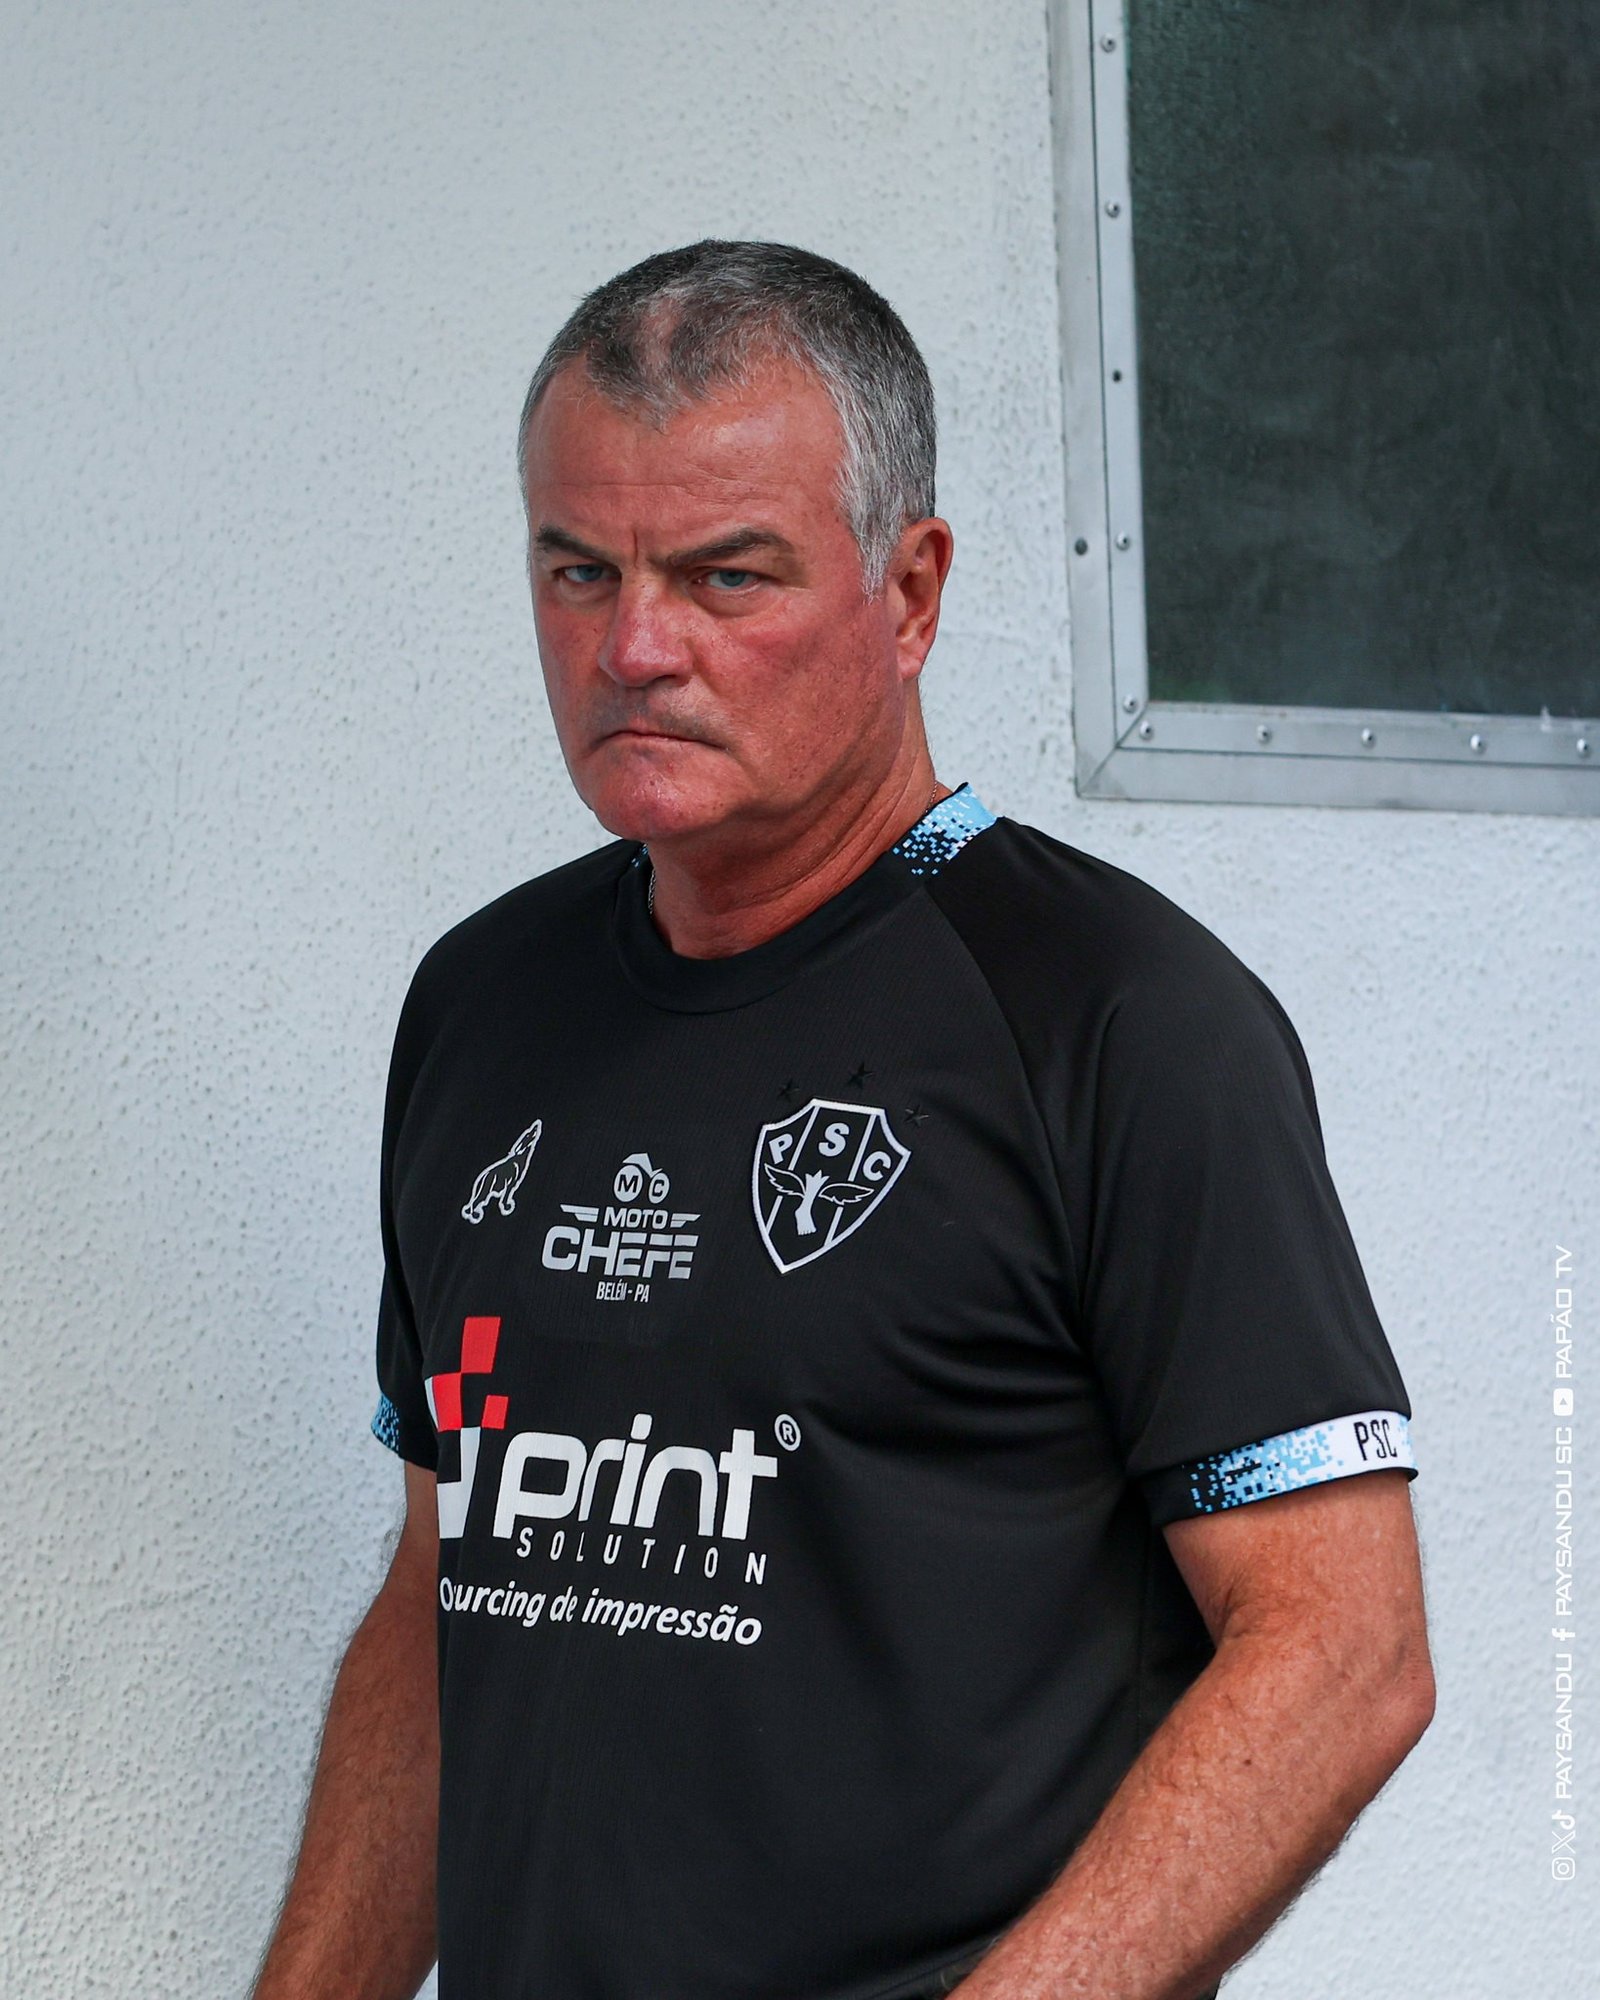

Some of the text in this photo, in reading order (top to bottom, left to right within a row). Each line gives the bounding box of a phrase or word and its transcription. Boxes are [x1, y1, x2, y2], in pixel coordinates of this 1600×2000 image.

[603, 1206, 669, 1230] MOTO
[541, 1225, 699, 1280] CHEFE
[1353, 1418, 1398, 1462] PSC
[516, 1526, 767, 1585] SOLUTION
[549, 1585, 579, 1623] de
[581, 1587, 763, 1647] impressão
